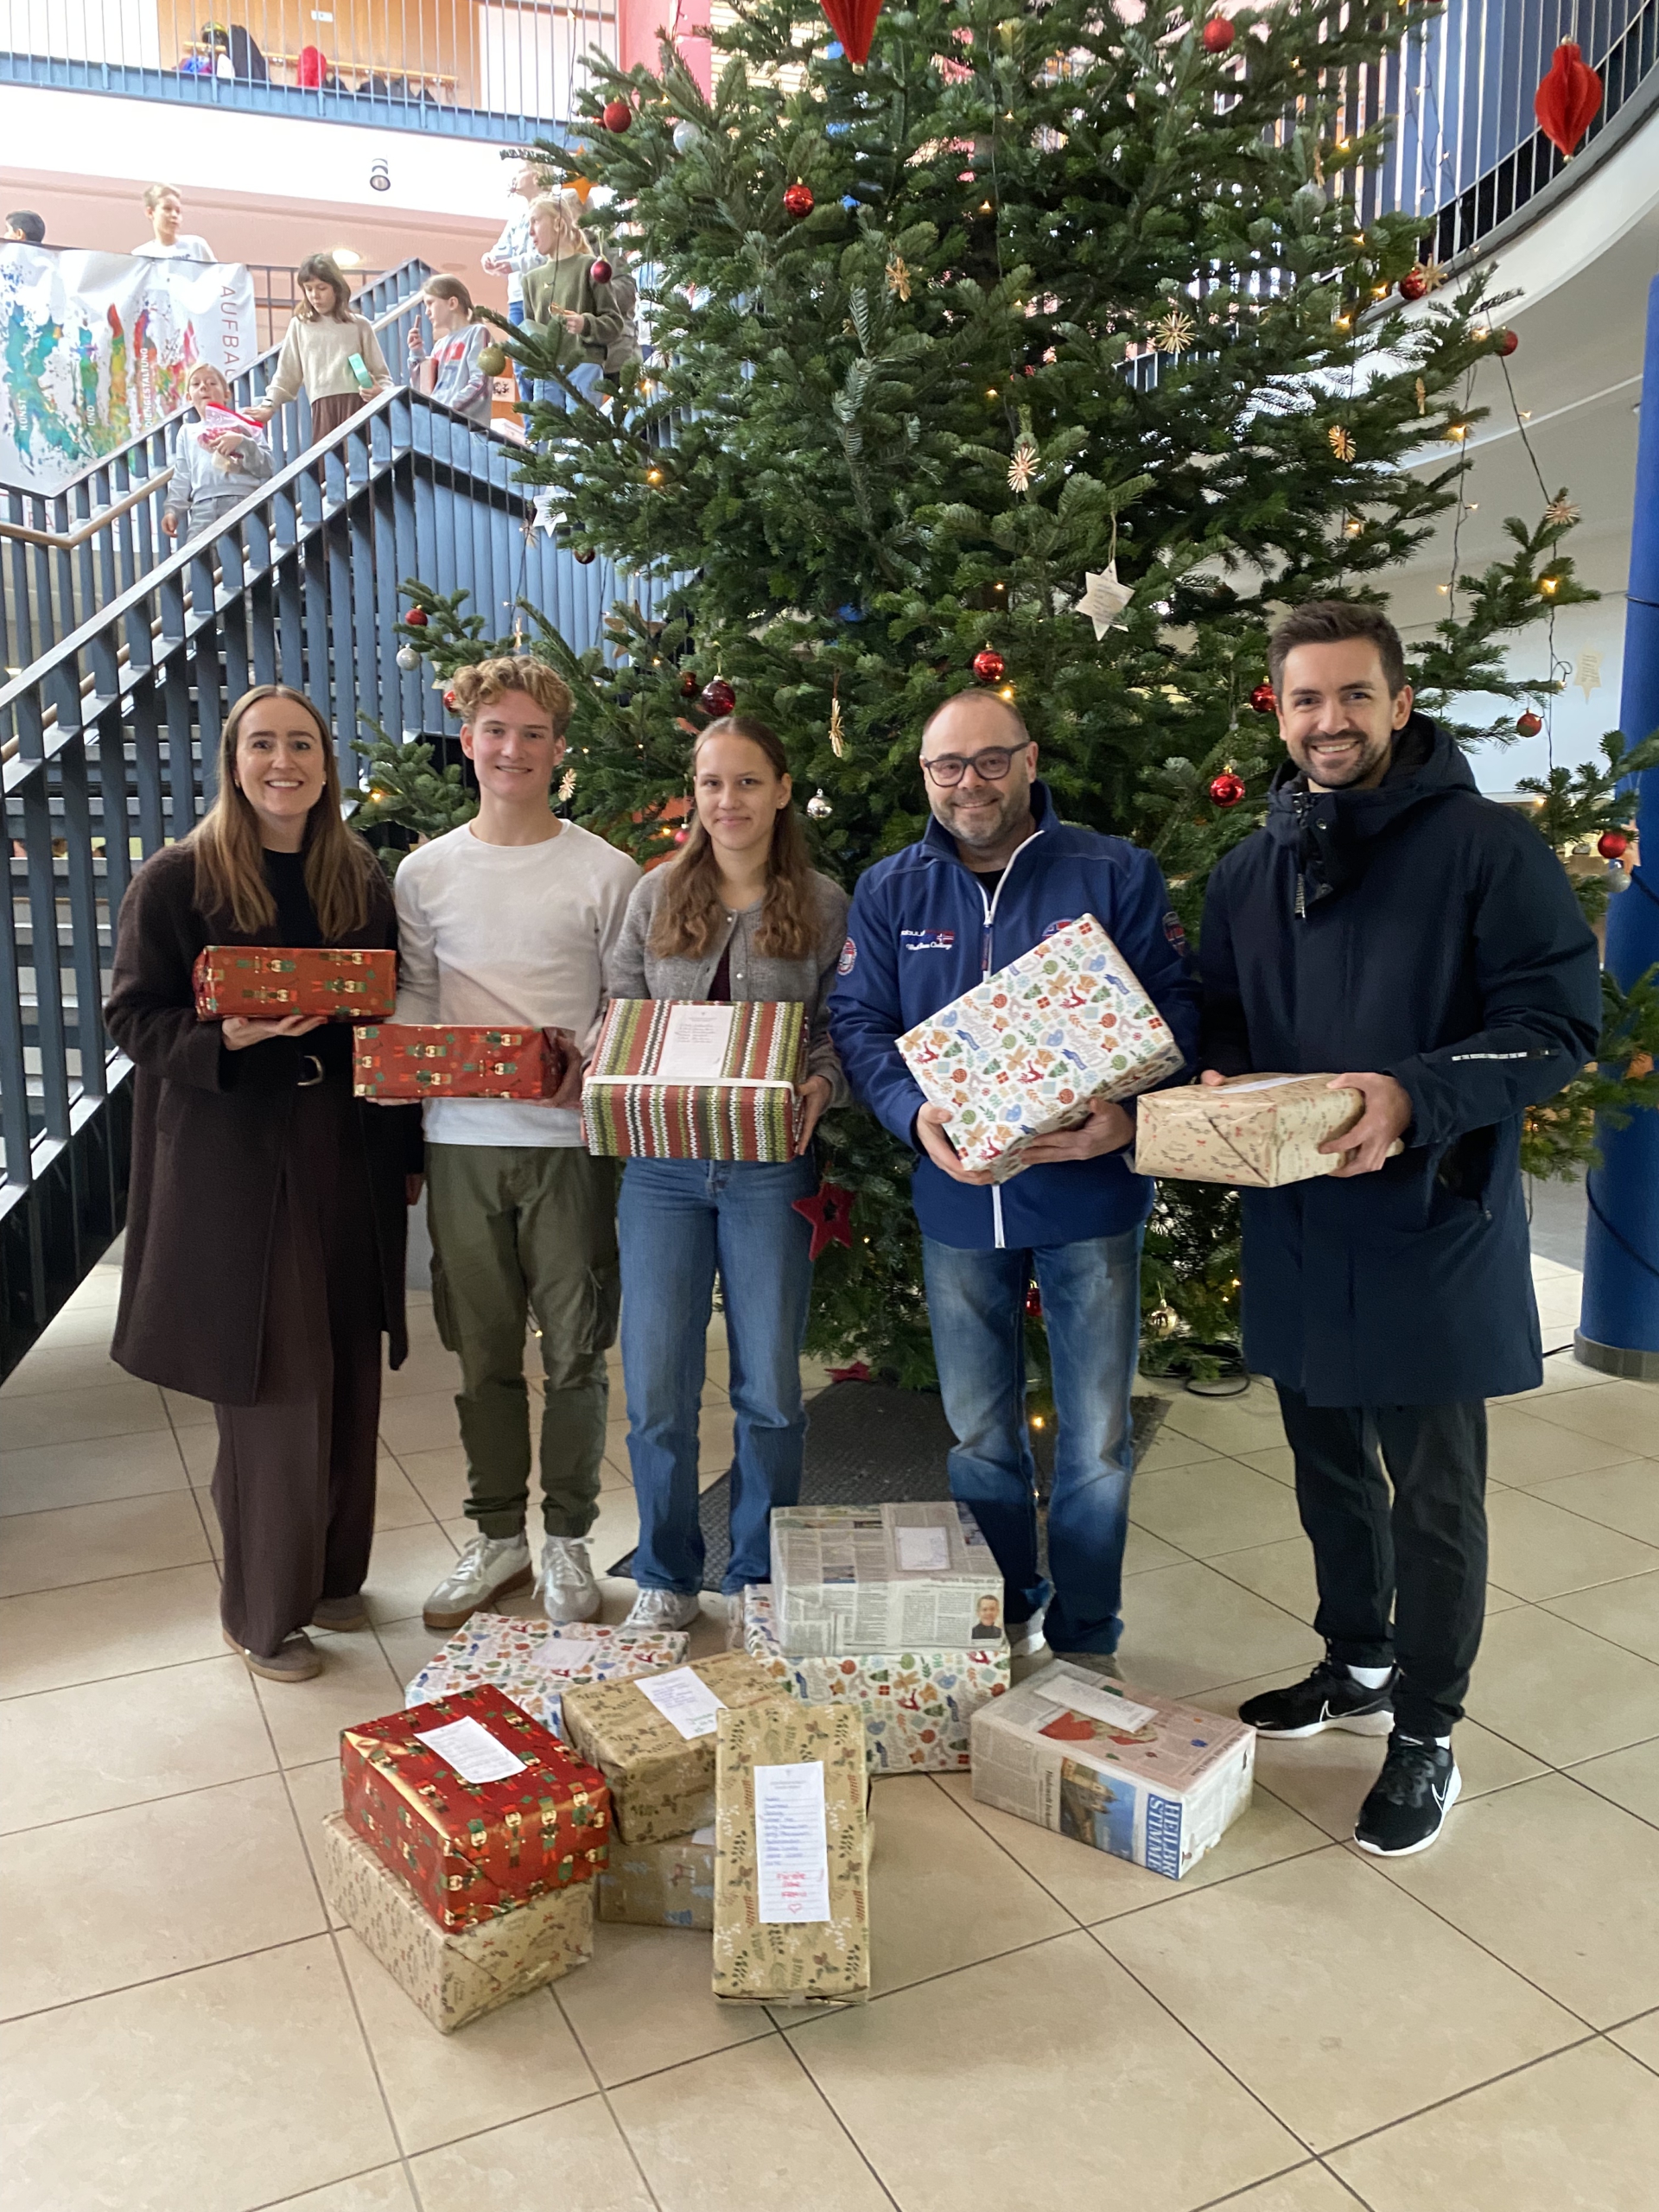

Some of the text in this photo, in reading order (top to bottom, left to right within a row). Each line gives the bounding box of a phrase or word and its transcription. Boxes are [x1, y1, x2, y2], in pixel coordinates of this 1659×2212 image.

[140, 347, 152, 428] DIENGESTALTUNG
[19, 399, 29, 431] KUNST
[86, 404, 96, 427] UND
[1147, 1796, 1164, 1872] STIMME
